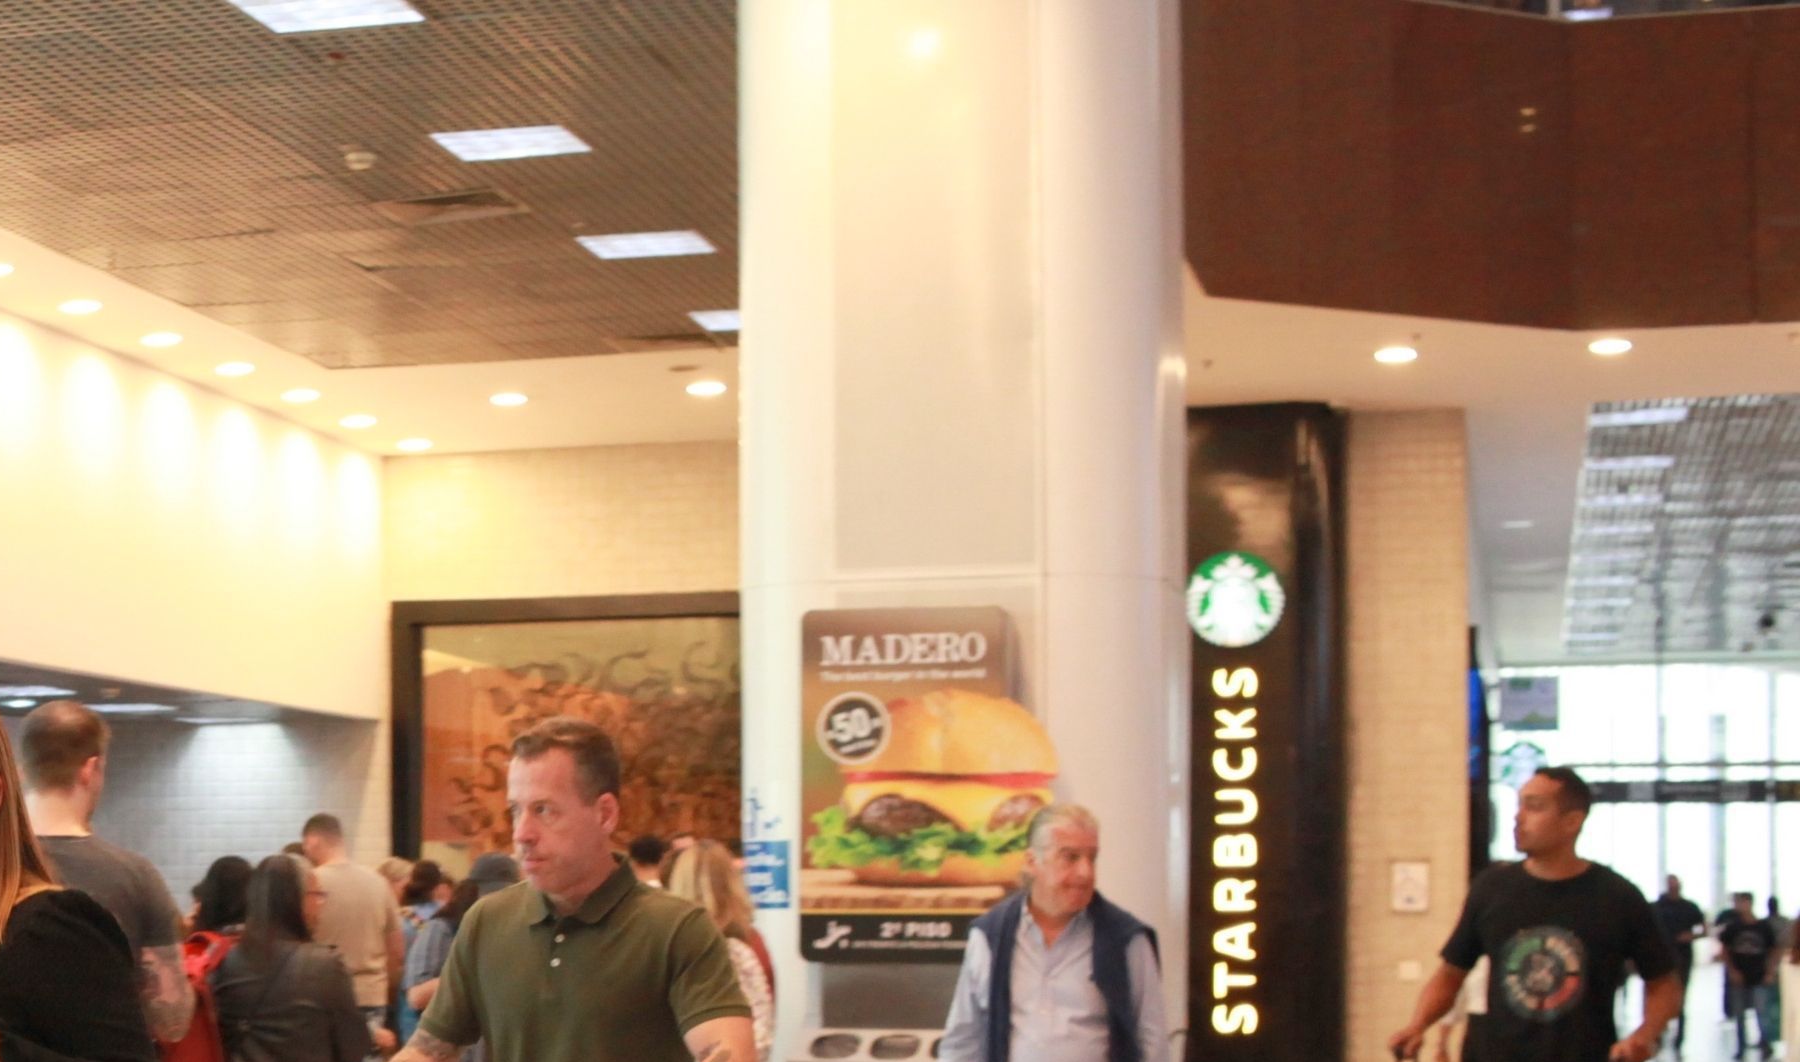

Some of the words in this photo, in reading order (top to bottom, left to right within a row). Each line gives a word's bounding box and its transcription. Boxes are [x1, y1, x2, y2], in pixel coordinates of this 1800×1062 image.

[819, 631, 988, 667] MADERO
[1211, 666, 1260, 1036] STARBUCKS
[903, 921, 952, 939] PISO
